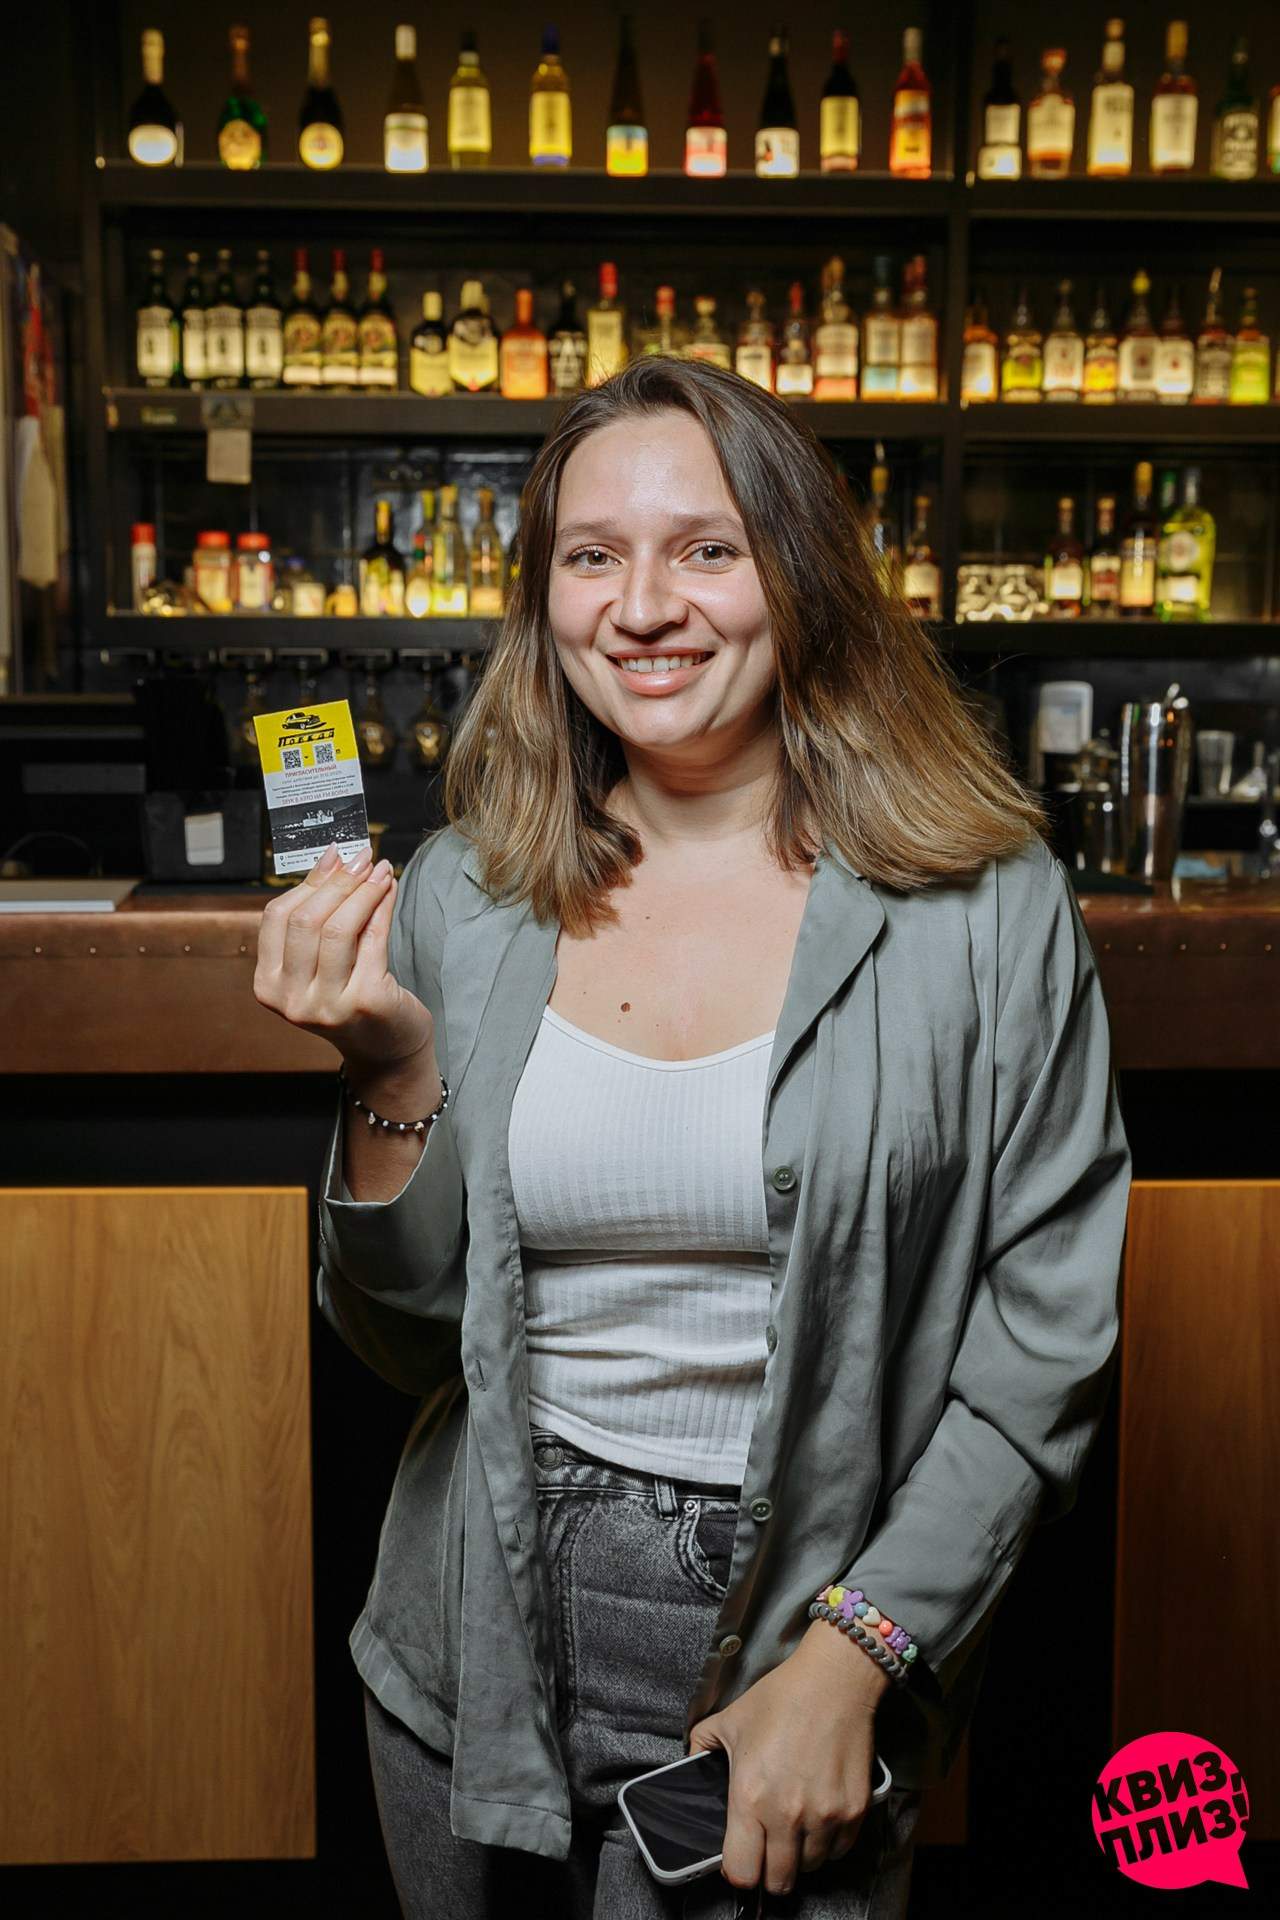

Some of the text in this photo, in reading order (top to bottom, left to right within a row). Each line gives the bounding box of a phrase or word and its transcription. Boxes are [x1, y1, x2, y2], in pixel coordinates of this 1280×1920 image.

[285, 764, 337, 778] ПРИГЛАСИТЕЛЬНЫЙ
[282, 797, 295, 805] ЗВУК
[300, 794, 313, 803] АВТО
[314, 793, 322, 801] НА
[331, 788, 350, 798] ВОЛНЕ
